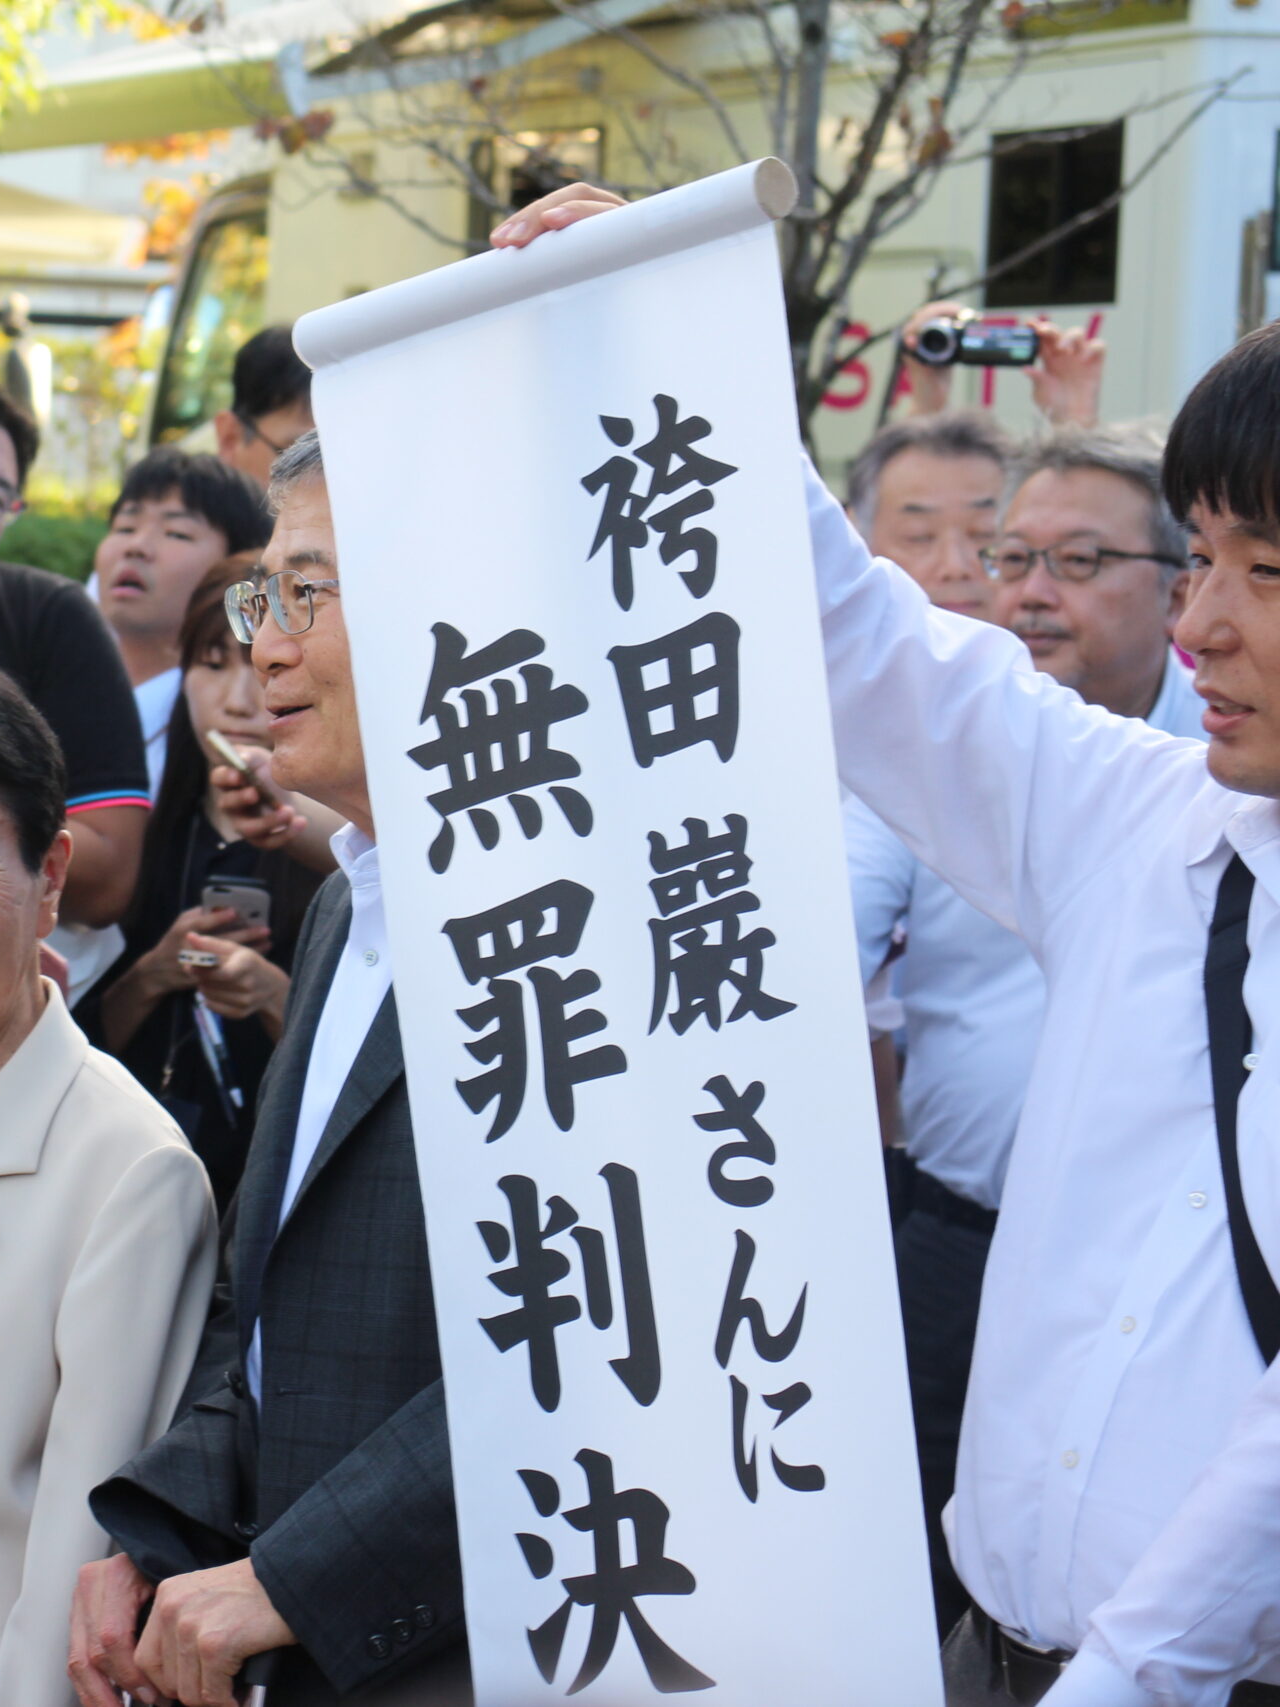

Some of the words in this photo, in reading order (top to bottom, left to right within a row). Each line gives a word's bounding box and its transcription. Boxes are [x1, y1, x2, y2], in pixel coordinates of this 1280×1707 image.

[406, 621, 717, 1697] 無罪判決
[580, 393, 826, 1504] 袴田巖さんに
